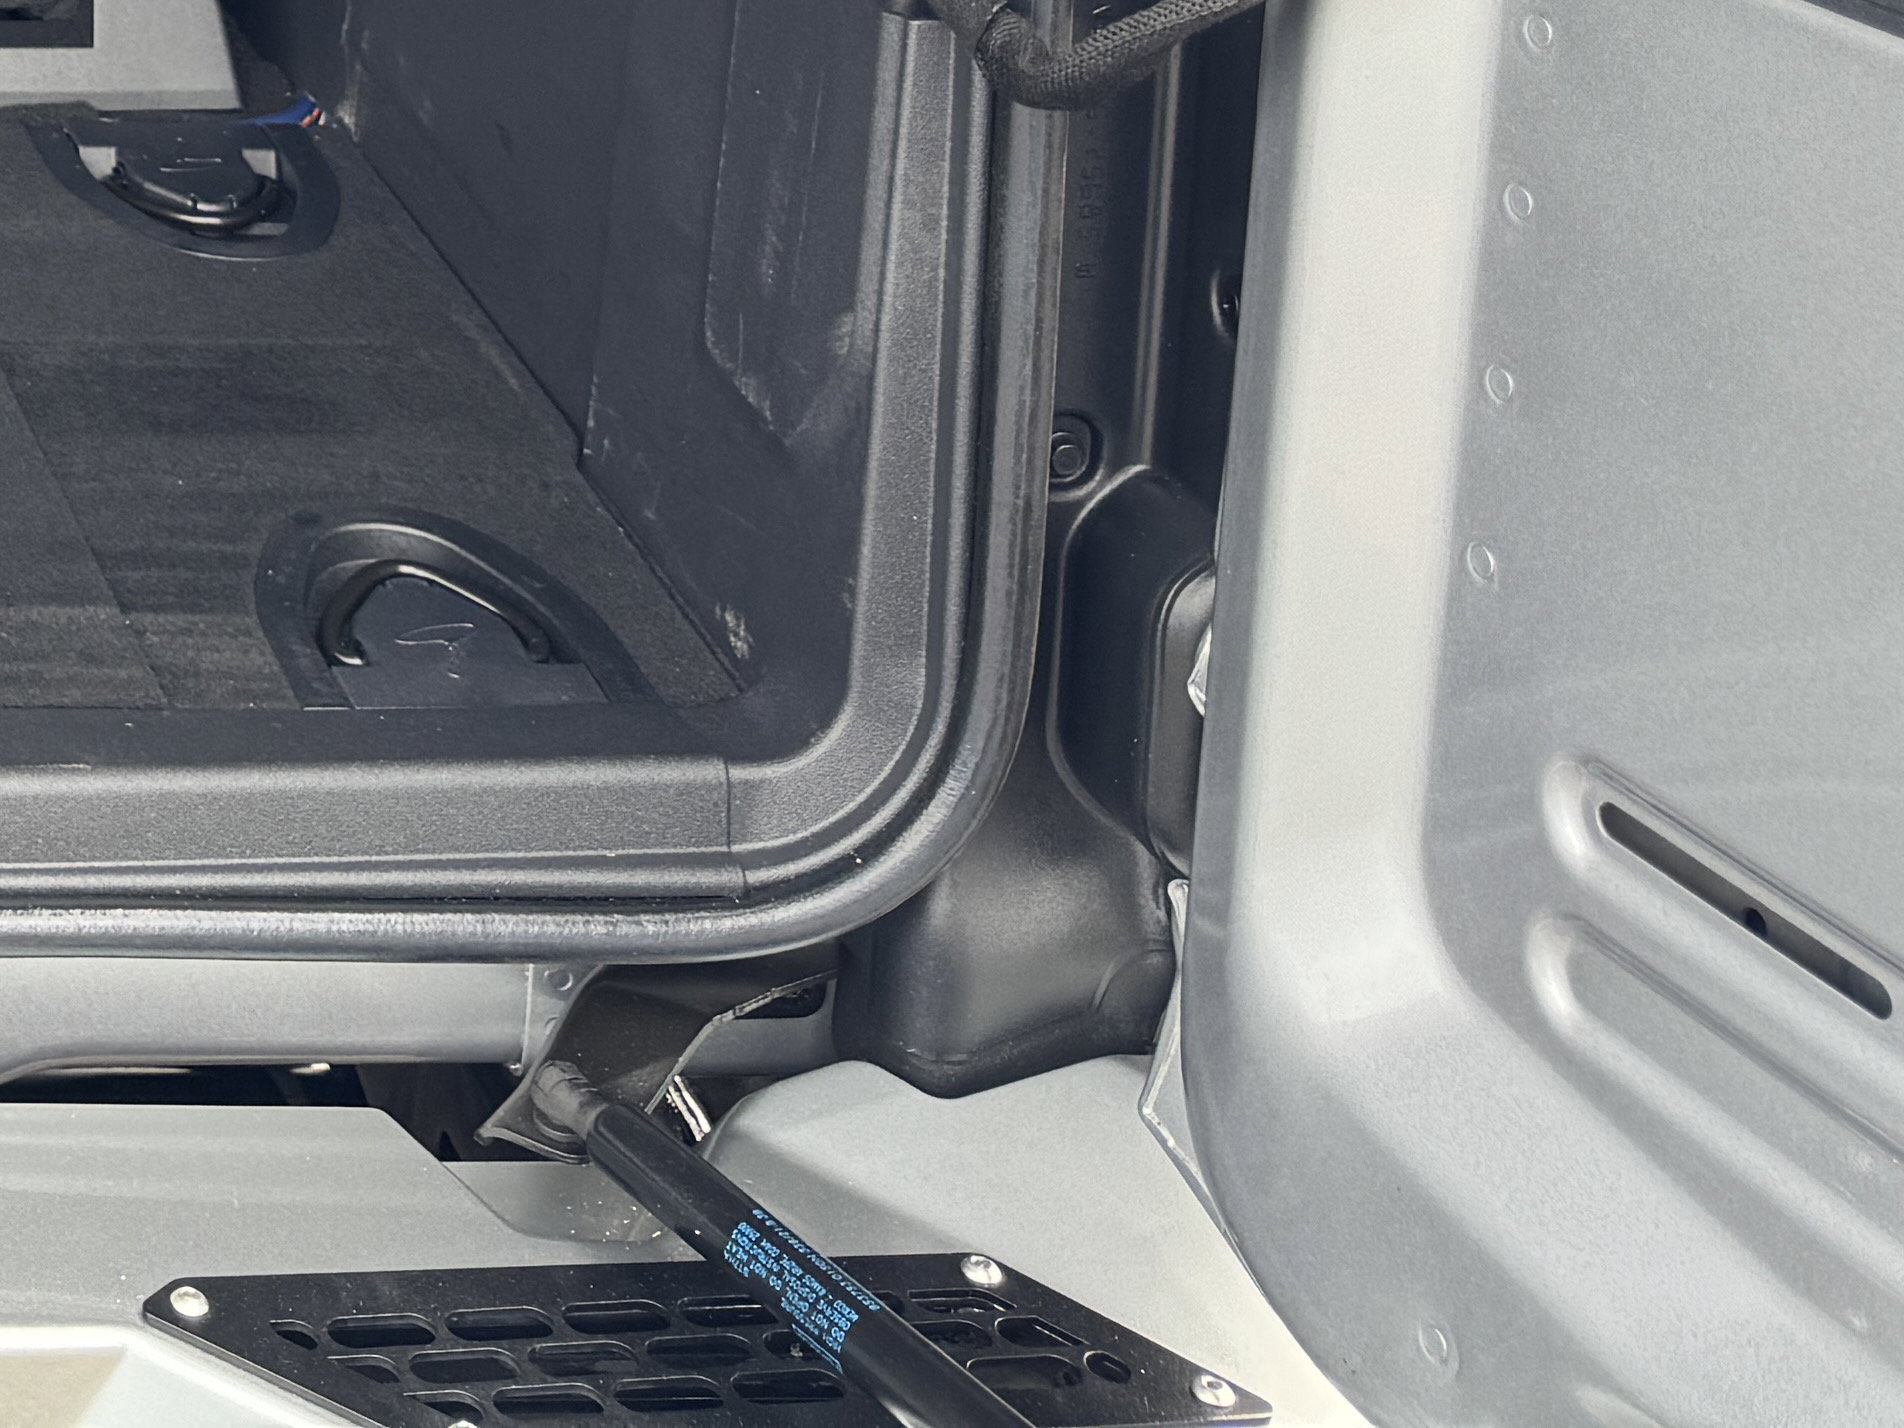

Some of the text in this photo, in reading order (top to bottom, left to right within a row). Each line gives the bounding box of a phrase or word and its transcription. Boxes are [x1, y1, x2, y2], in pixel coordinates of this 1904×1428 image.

[724, 1239, 749, 1263] HEAT
[748, 1259, 768, 1279] NOT
[729, 1228, 851, 1331] OBSERVE DISPOSAL INSTRUCTIONS
[767, 1274, 783, 1291] DO
[810, 1310, 830, 1329] NOT
[830, 1325, 846, 1342] DO
